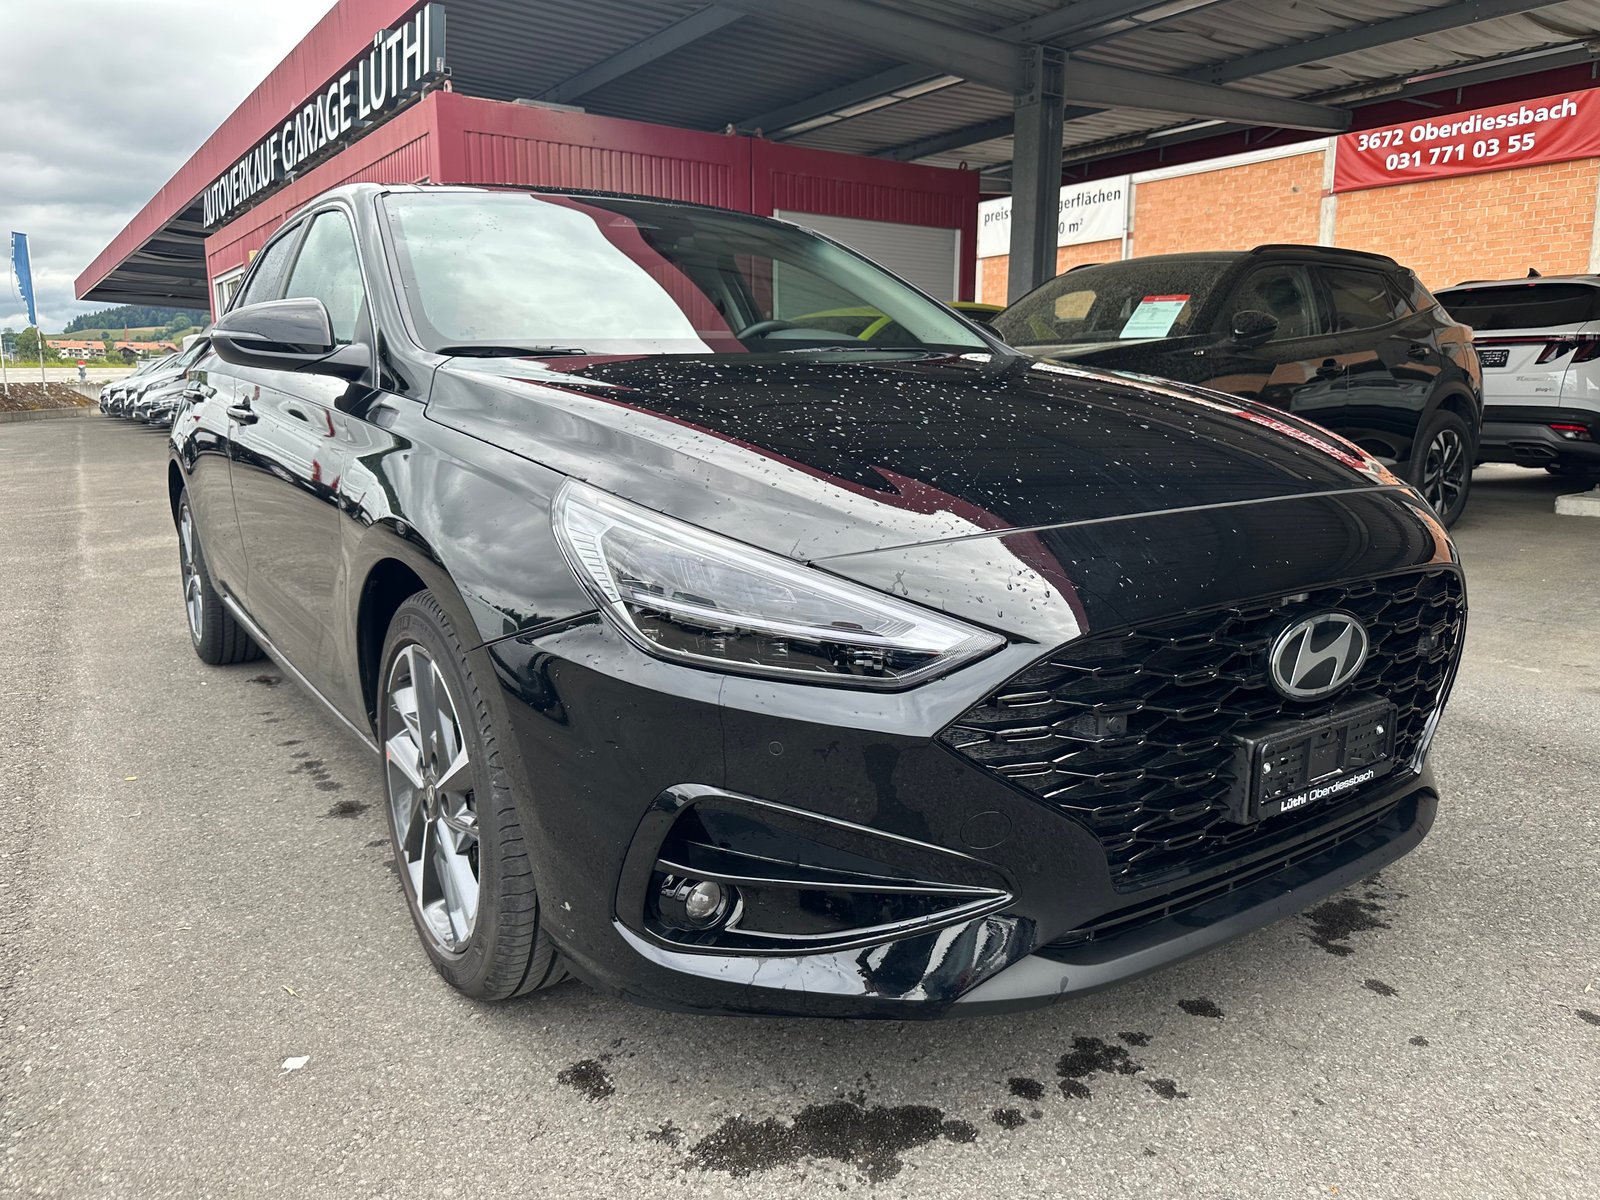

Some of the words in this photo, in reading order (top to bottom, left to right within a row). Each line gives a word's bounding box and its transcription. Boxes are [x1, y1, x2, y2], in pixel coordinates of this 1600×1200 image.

[203, 131, 278, 229] AUTOVERKAUF
[281, 70, 351, 172] GARAGE
[358, 2, 431, 121] LÜTHI
[1357, 128, 1404, 152] 3672
[1409, 98, 1578, 143] Oberdiessbach
[1385, 150, 1421, 172] 031
[1429, 143, 1465, 166] 771
[1472, 138, 1500, 160] 03
[1507, 131, 1537, 154] 55
[984, 206, 1012, 227] preis
[1309, 769, 1374, 801] Oberdiessbach
